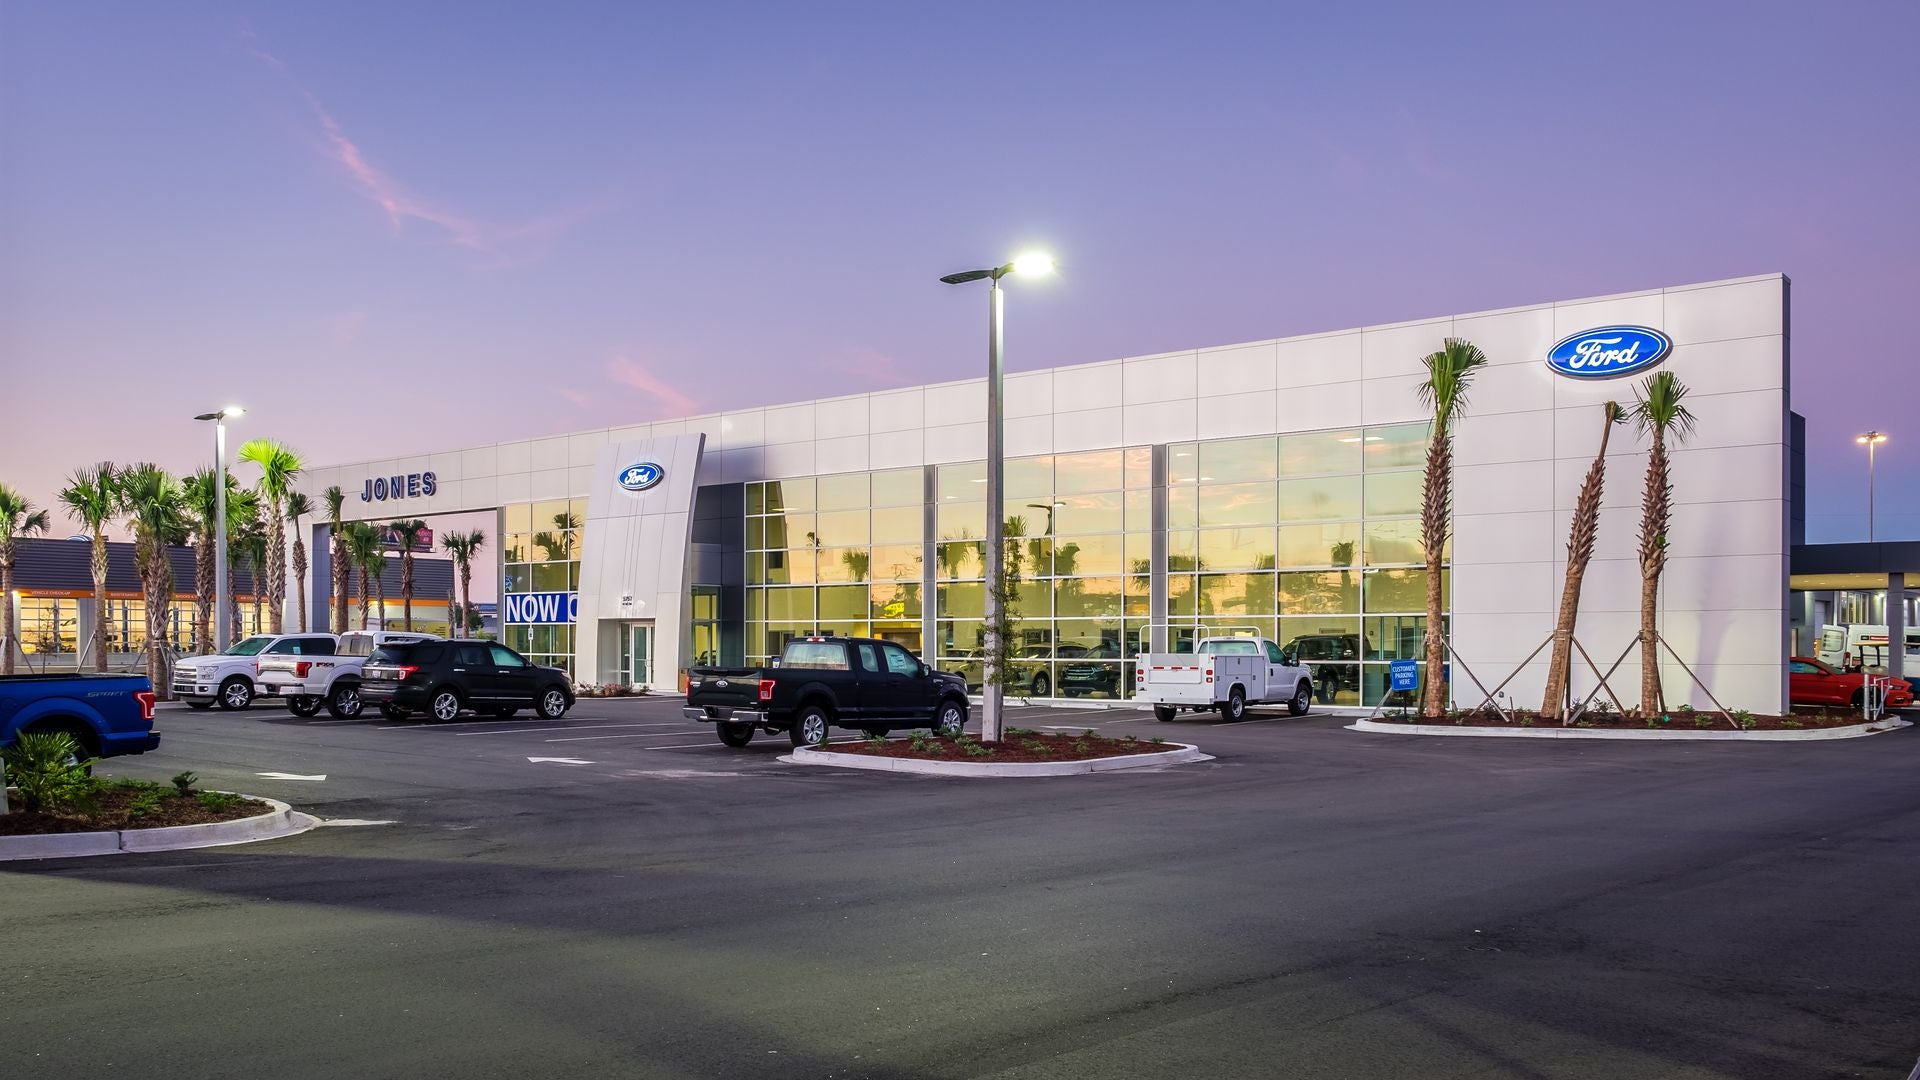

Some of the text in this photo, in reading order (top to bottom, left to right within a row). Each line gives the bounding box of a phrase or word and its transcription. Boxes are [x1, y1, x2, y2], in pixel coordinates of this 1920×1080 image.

[1569, 337, 1640, 369] Ford
[361, 472, 437, 502] JONES
[624, 468, 650, 484] Ford
[506, 595, 560, 622] NOW
